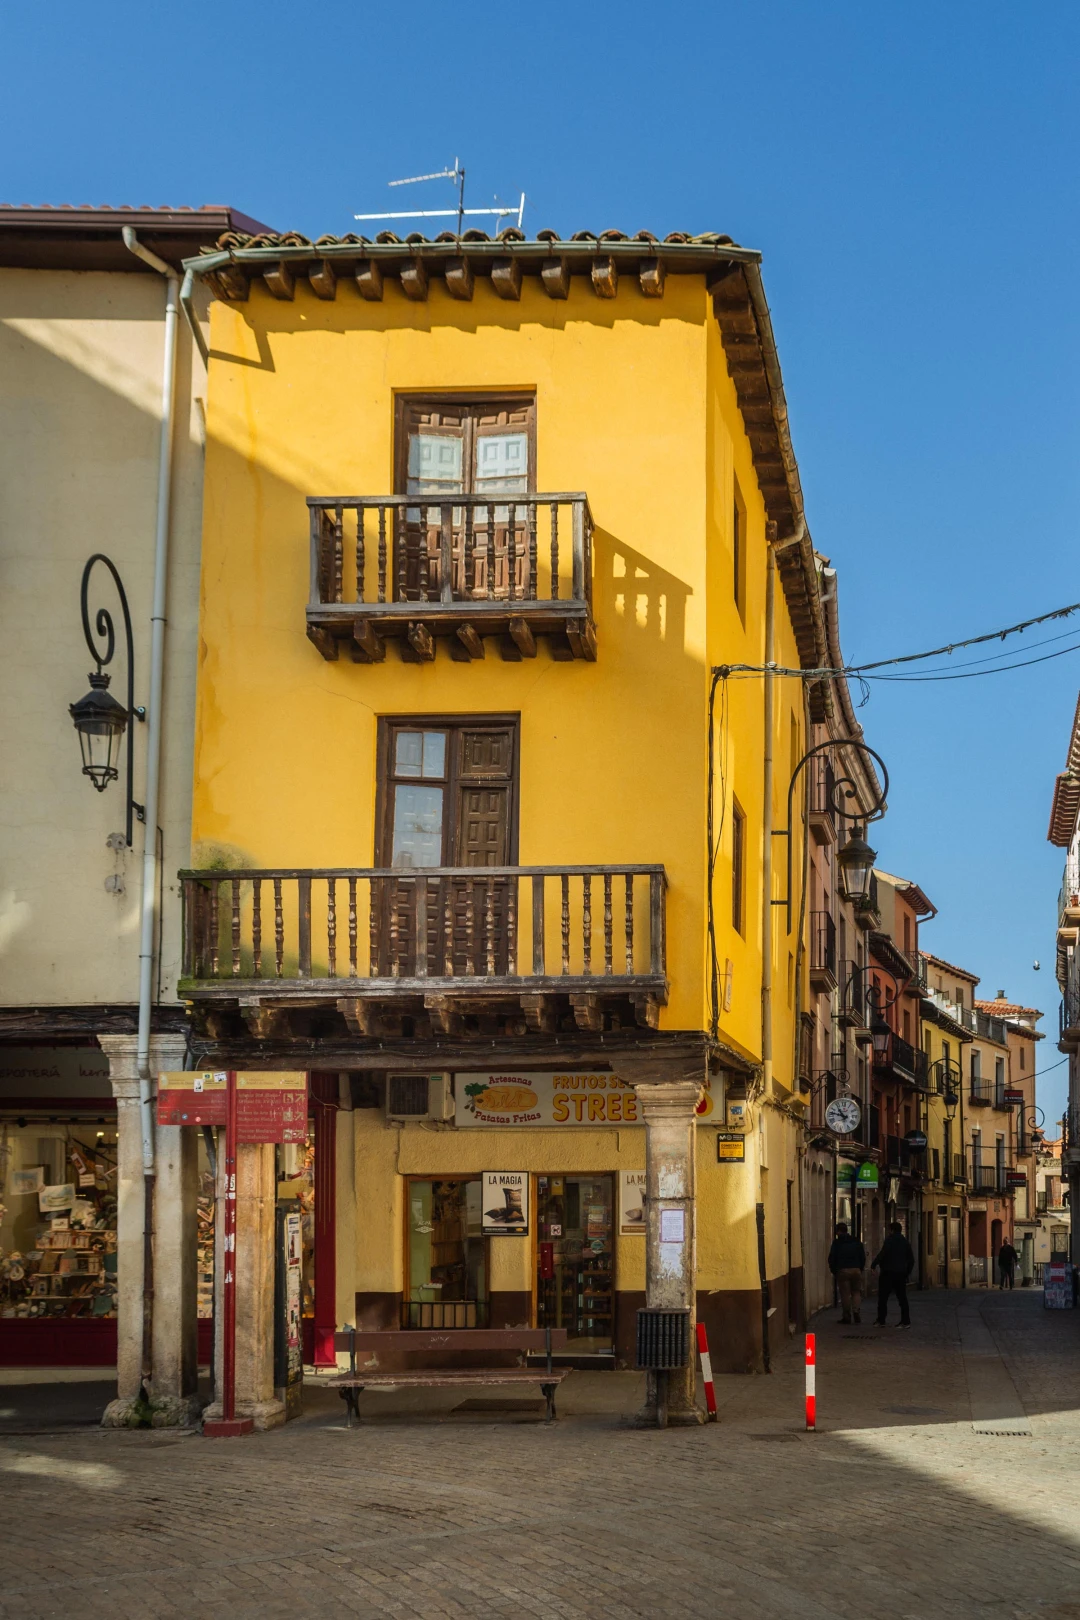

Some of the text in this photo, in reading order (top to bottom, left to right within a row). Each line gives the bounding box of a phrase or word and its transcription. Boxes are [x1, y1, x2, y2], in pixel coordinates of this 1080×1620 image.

[489, 1076, 533, 1086] Artesanas
[553, 1075, 633, 1089] FRUTOS SE
[553, 1093, 645, 1122] STREE
[474, 1111, 542, 1124] Patatas Fritas
[488, 1175, 522, 1185] LA MAGIA
[626, 1175, 635, 1185] LA
